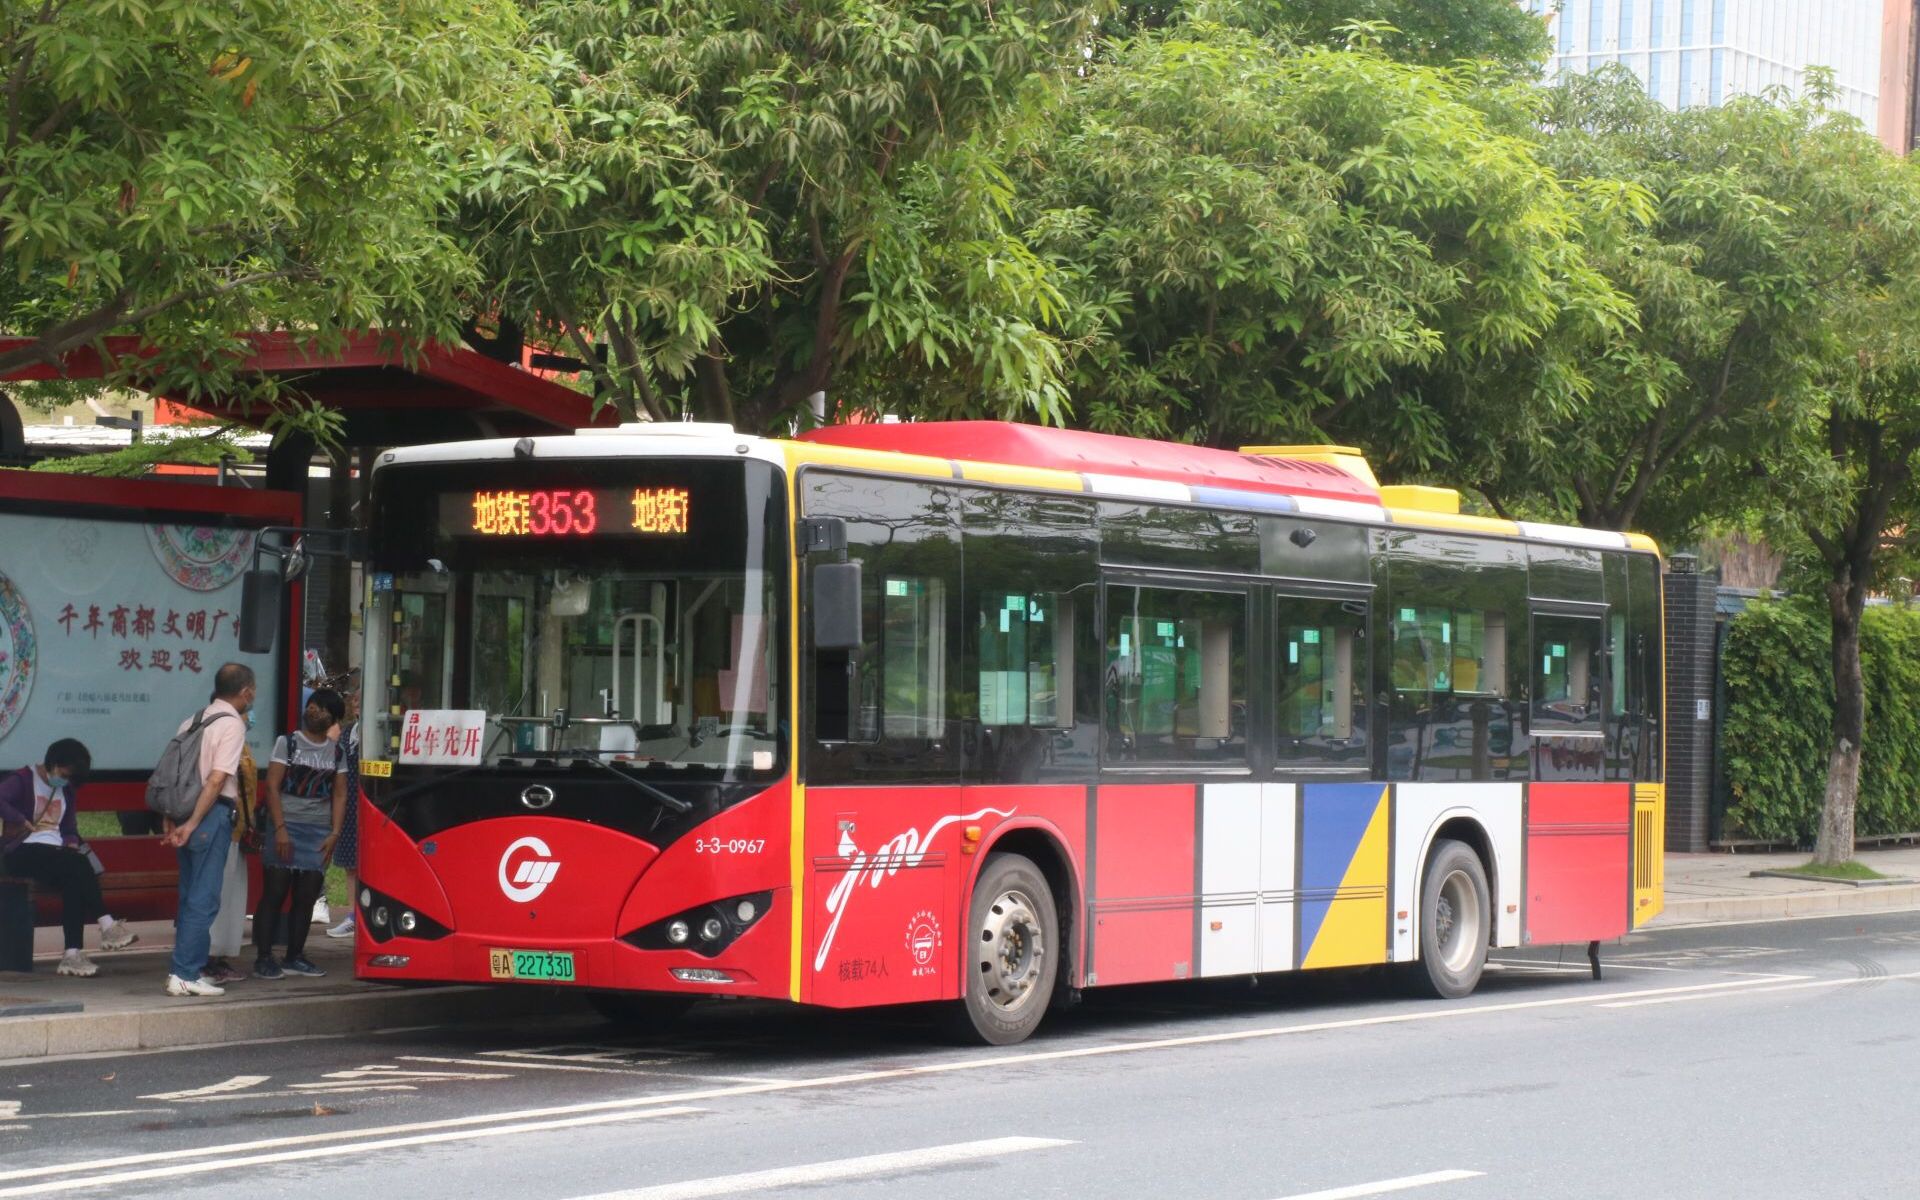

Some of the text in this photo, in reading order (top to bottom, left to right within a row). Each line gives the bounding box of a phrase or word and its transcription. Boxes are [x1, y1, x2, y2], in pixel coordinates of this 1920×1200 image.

[529, 491, 596, 535] 353
[632, 488, 688, 533] 地铁
[117, 648, 203, 674] 欢迎您
[403, 725, 481, 757] 此车先开
[695, 837, 766, 854] 3-3-0967
[839, 956, 889, 981] 核载74人
